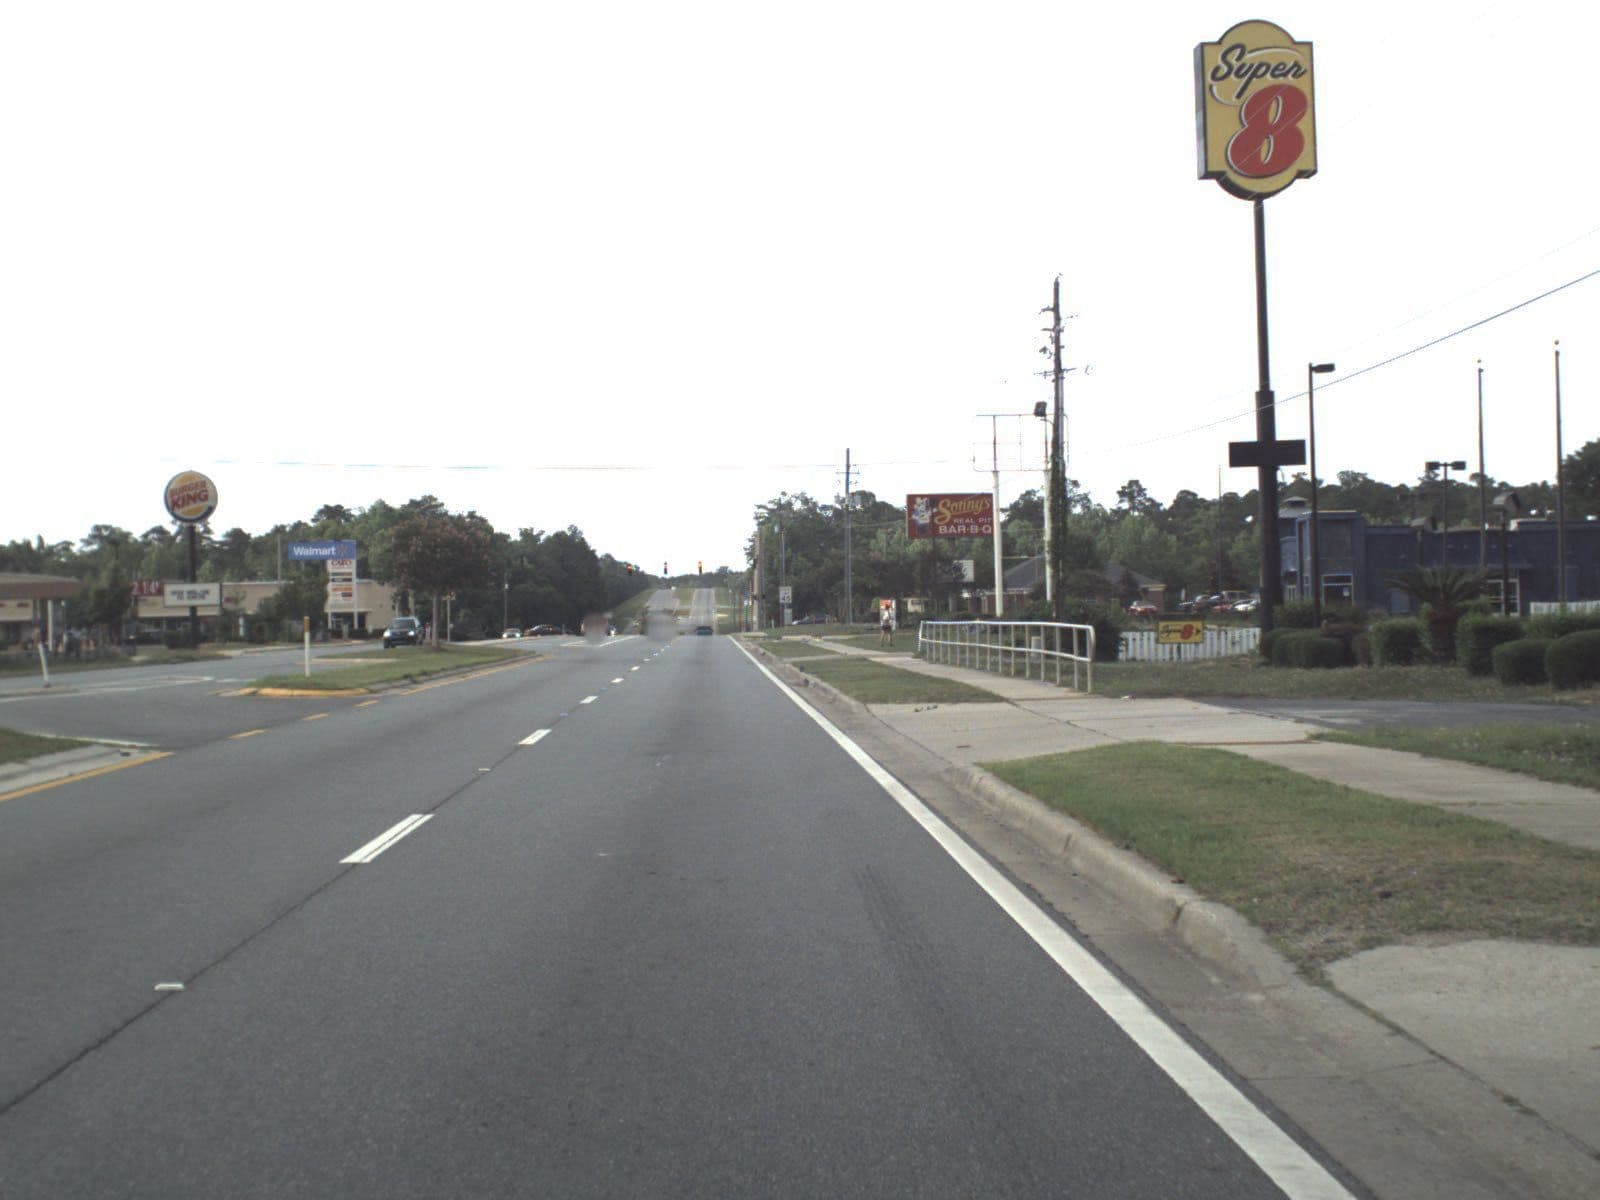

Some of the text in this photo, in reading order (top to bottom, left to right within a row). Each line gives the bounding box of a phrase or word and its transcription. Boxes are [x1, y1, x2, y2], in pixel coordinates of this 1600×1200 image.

[1209, 43, 1308, 100] Super
[1225, 83, 1309, 179] 8
[170, 489, 209, 512] KING
[935, 498, 991, 525] Sonny's
[293, 545, 337, 556] Walmart
